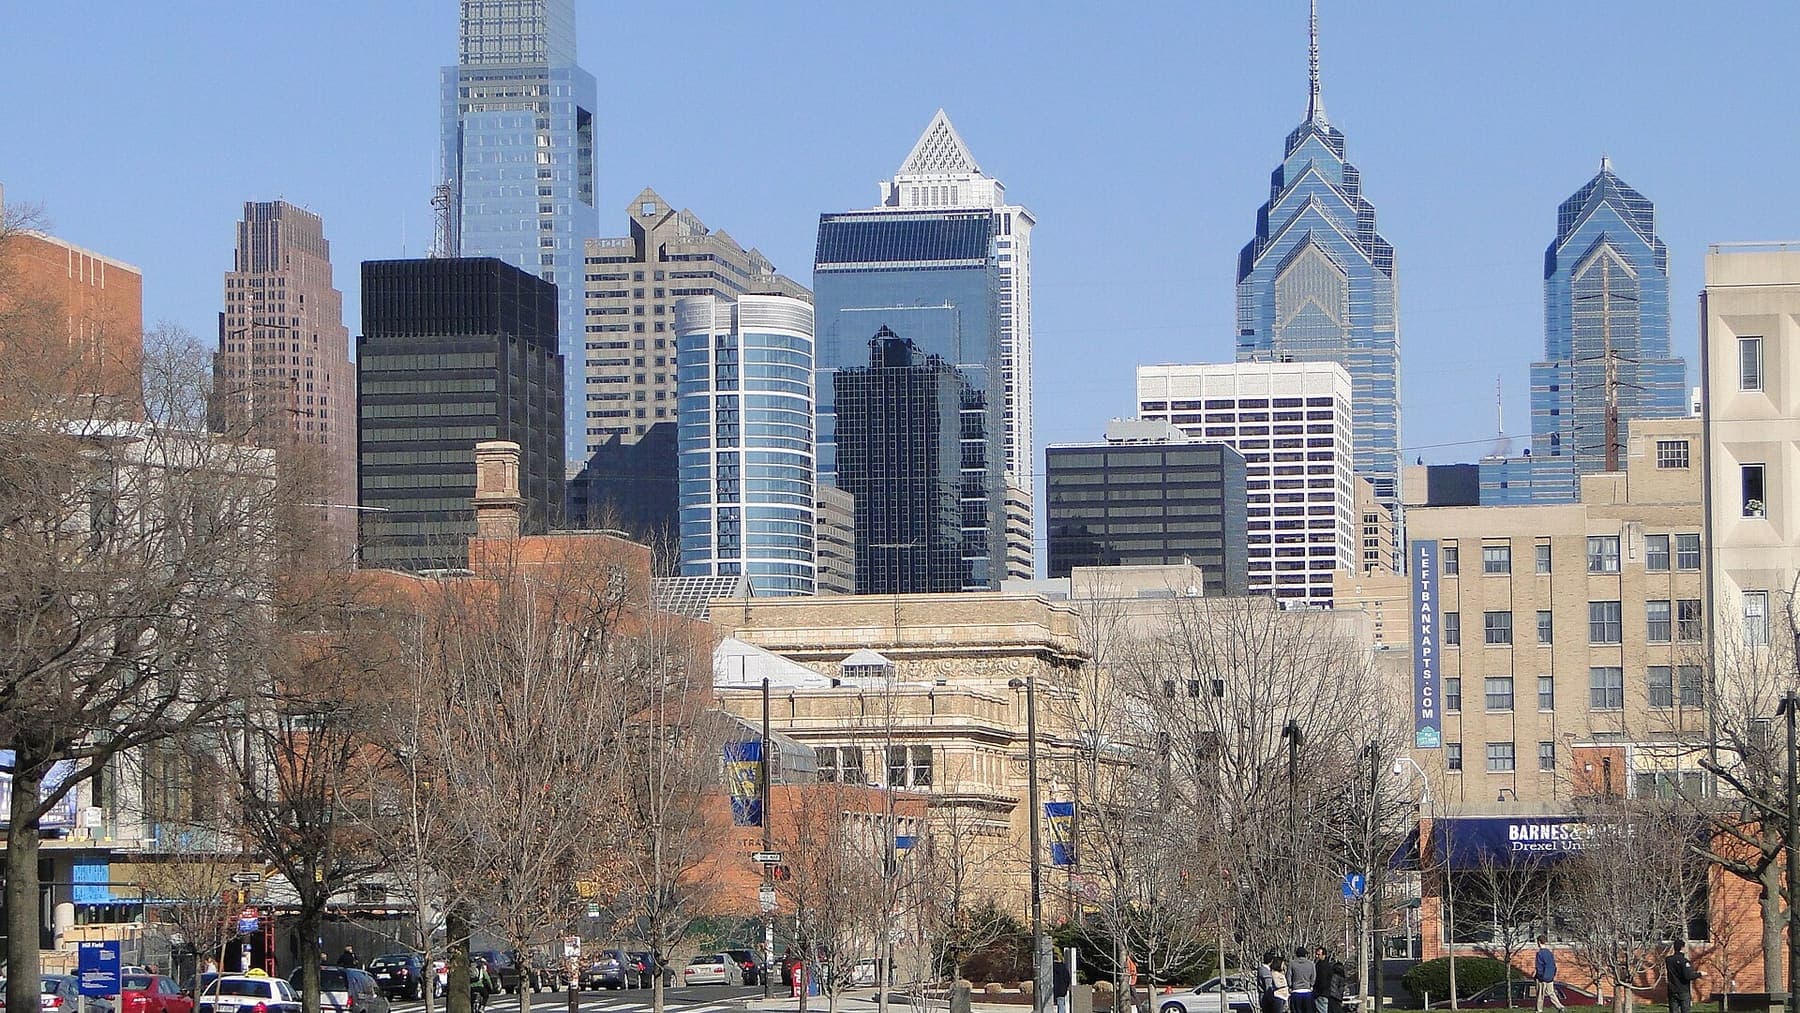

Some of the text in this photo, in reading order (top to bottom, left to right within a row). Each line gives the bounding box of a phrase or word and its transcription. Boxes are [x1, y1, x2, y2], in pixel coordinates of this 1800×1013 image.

[1420, 547, 1433, 719] LEFTBANKAPTS.COM
[1509, 824, 1568, 840] BARNES
[1512, 841, 1556, 851] Drexel
